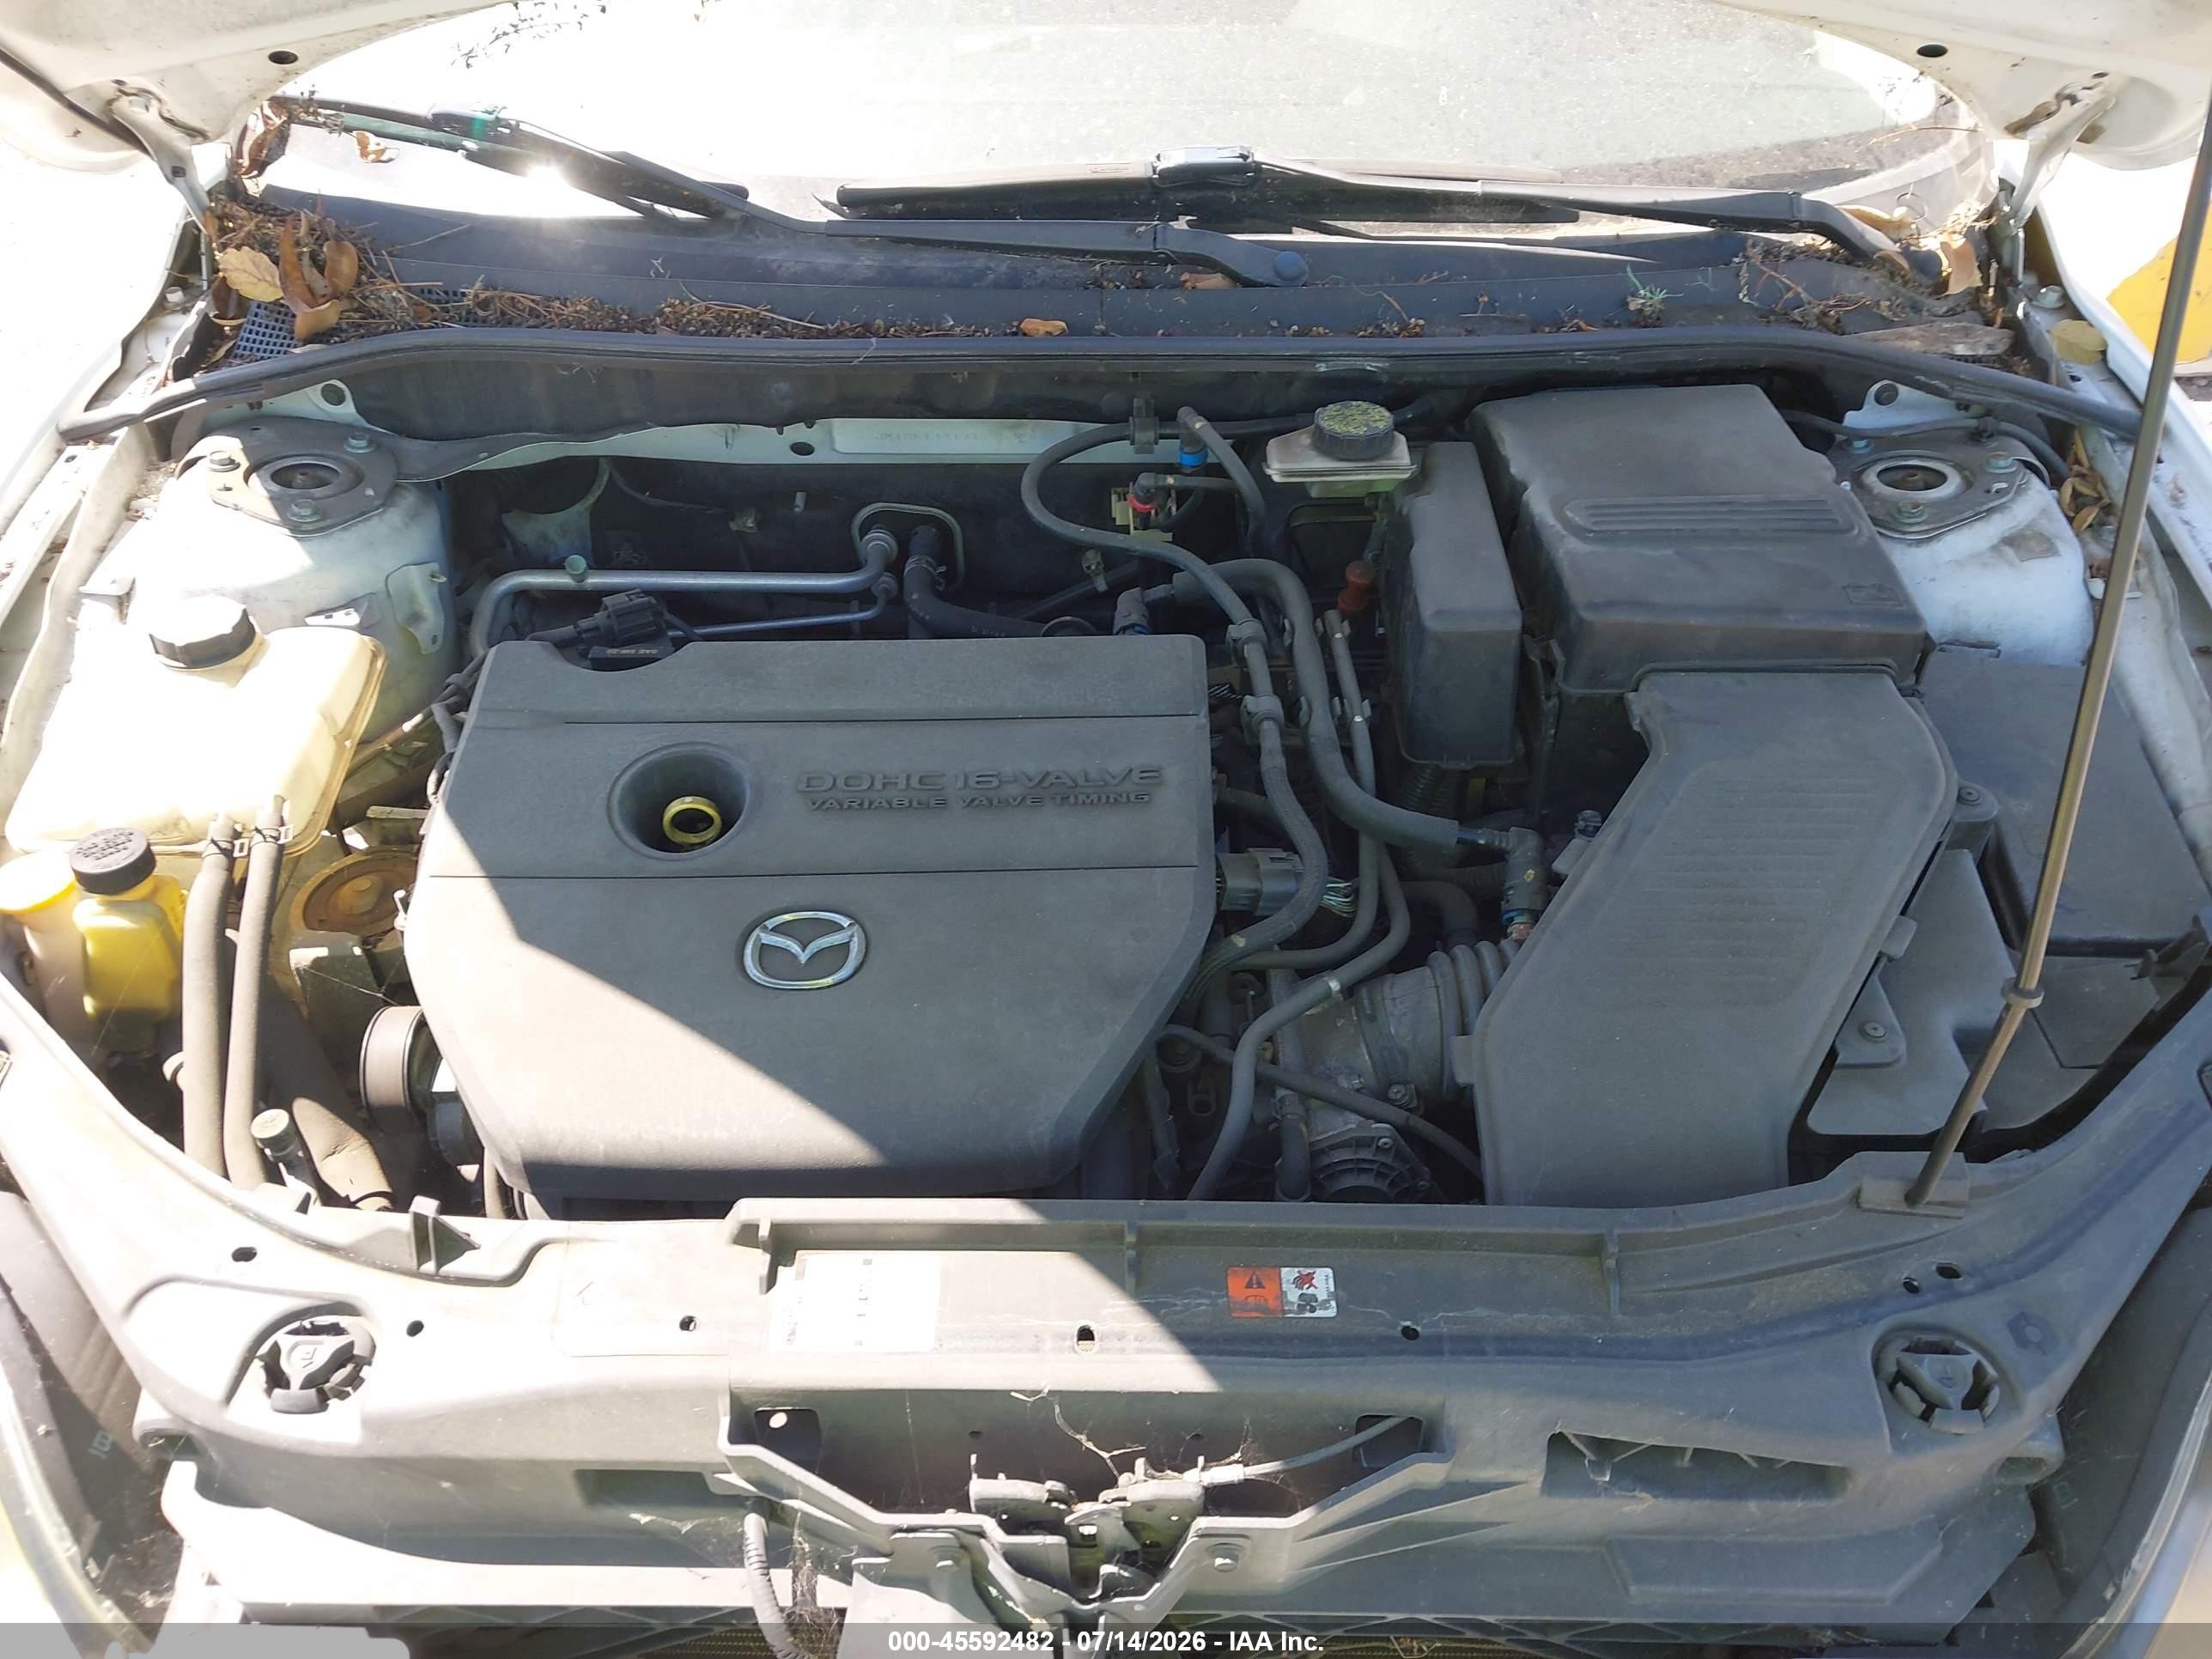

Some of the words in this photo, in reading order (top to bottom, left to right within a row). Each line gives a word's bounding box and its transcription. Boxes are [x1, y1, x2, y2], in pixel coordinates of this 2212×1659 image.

[798, 772, 945, 793] DOHC
[956, 767, 1164, 791] 16-VALVE
[809, 797, 947, 811] VARIABLE
[960, 794, 1043, 809] VALVE
[1051, 793, 1152, 806] TIMING
